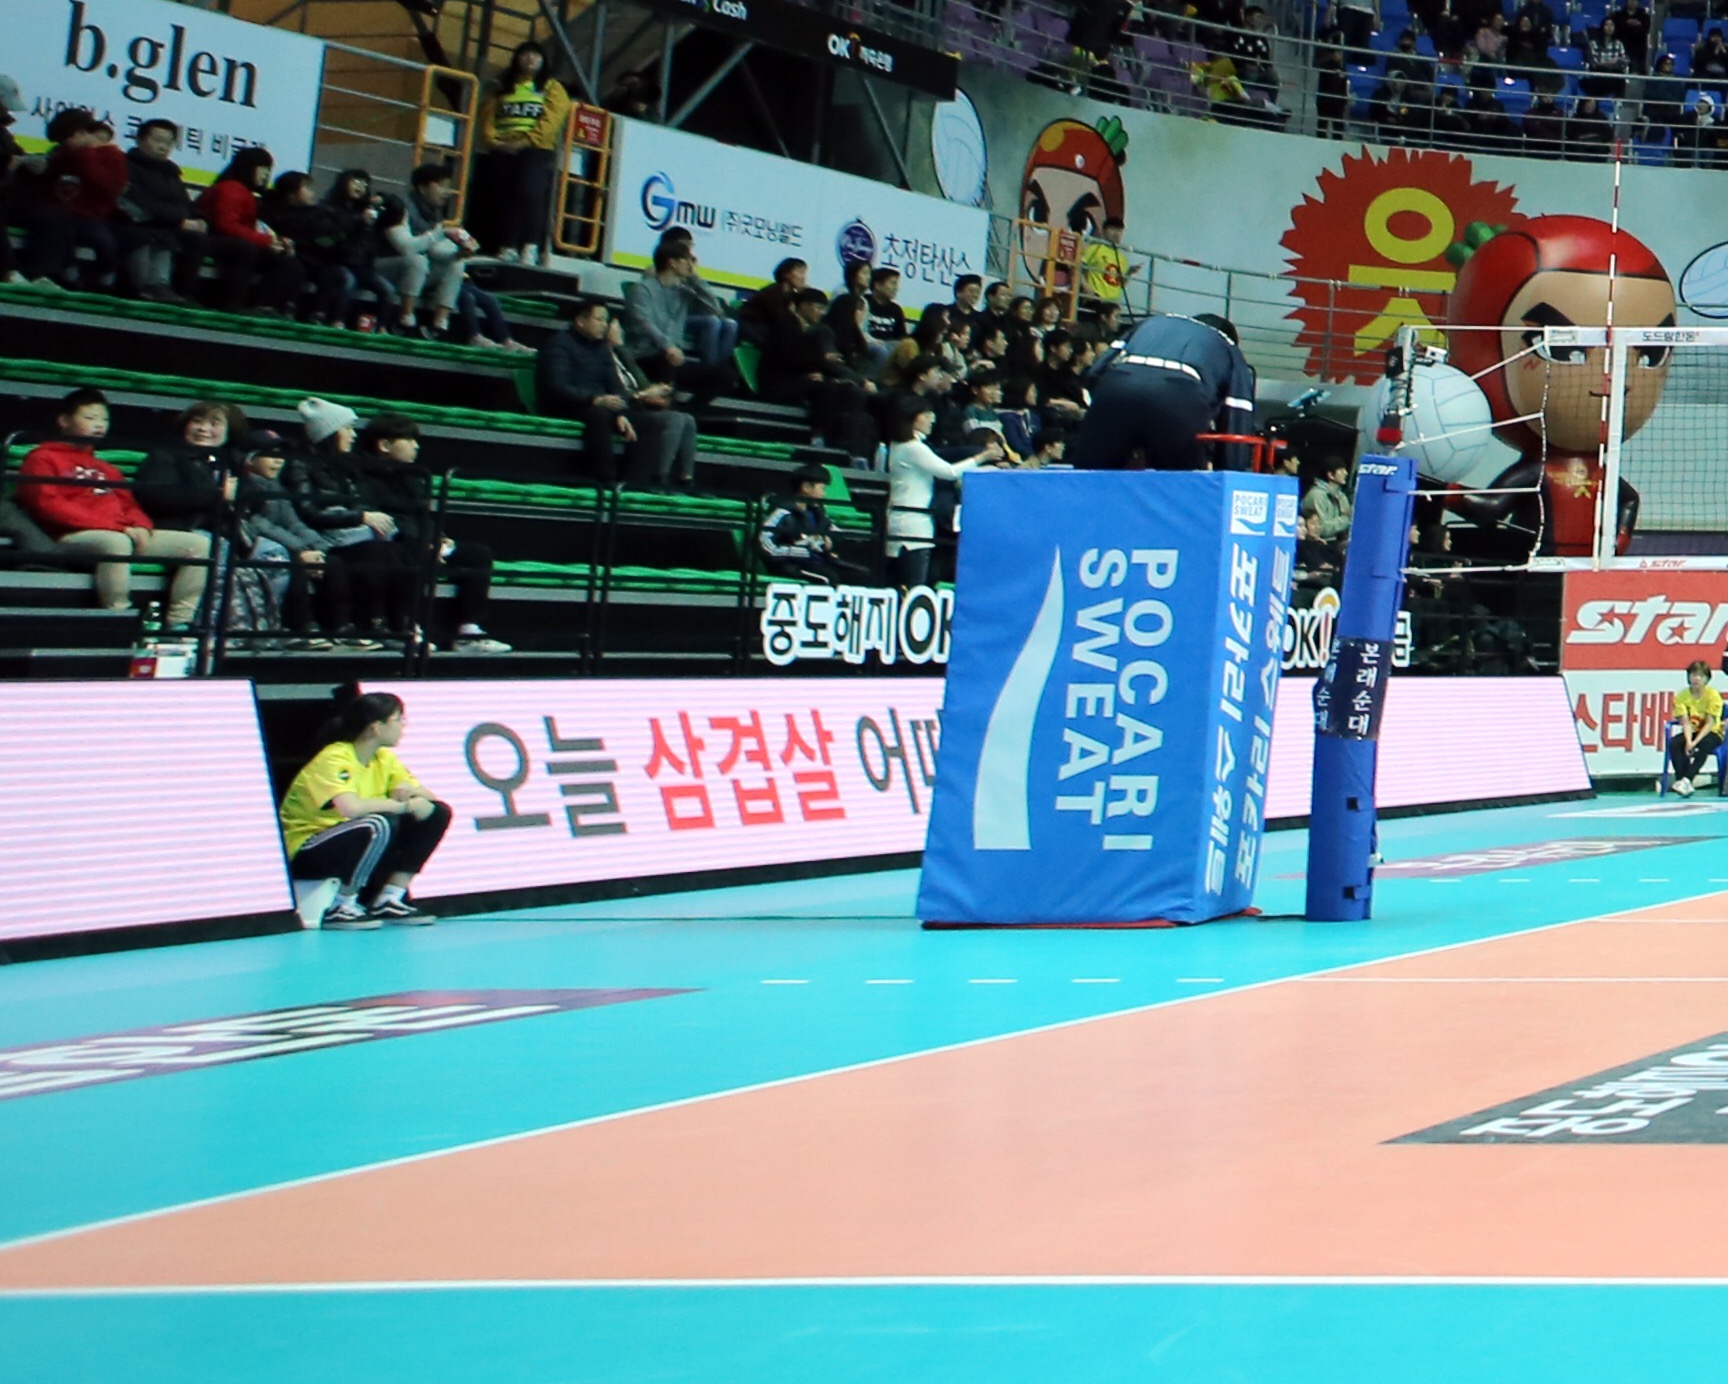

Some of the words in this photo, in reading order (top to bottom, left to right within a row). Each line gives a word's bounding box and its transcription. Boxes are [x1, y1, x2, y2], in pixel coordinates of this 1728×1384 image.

[64, 0, 259, 109] b.glen
[1233, 491, 1266, 505] POCARI
[1233, 504, 1265, 517] SWEAT
[1053, 547, 1128, 826] SWEAT
[1219, 542, 1259, 724] 포카리
[1346, 642, 1382, 738] 본래순대
[1103, 547, 1179, 852] POCARI
[464, 715, 628, 839] 오늘
[645, 709, 847, 832] 삼겹살
[1204, 725, 1238, 898] 스웨트
